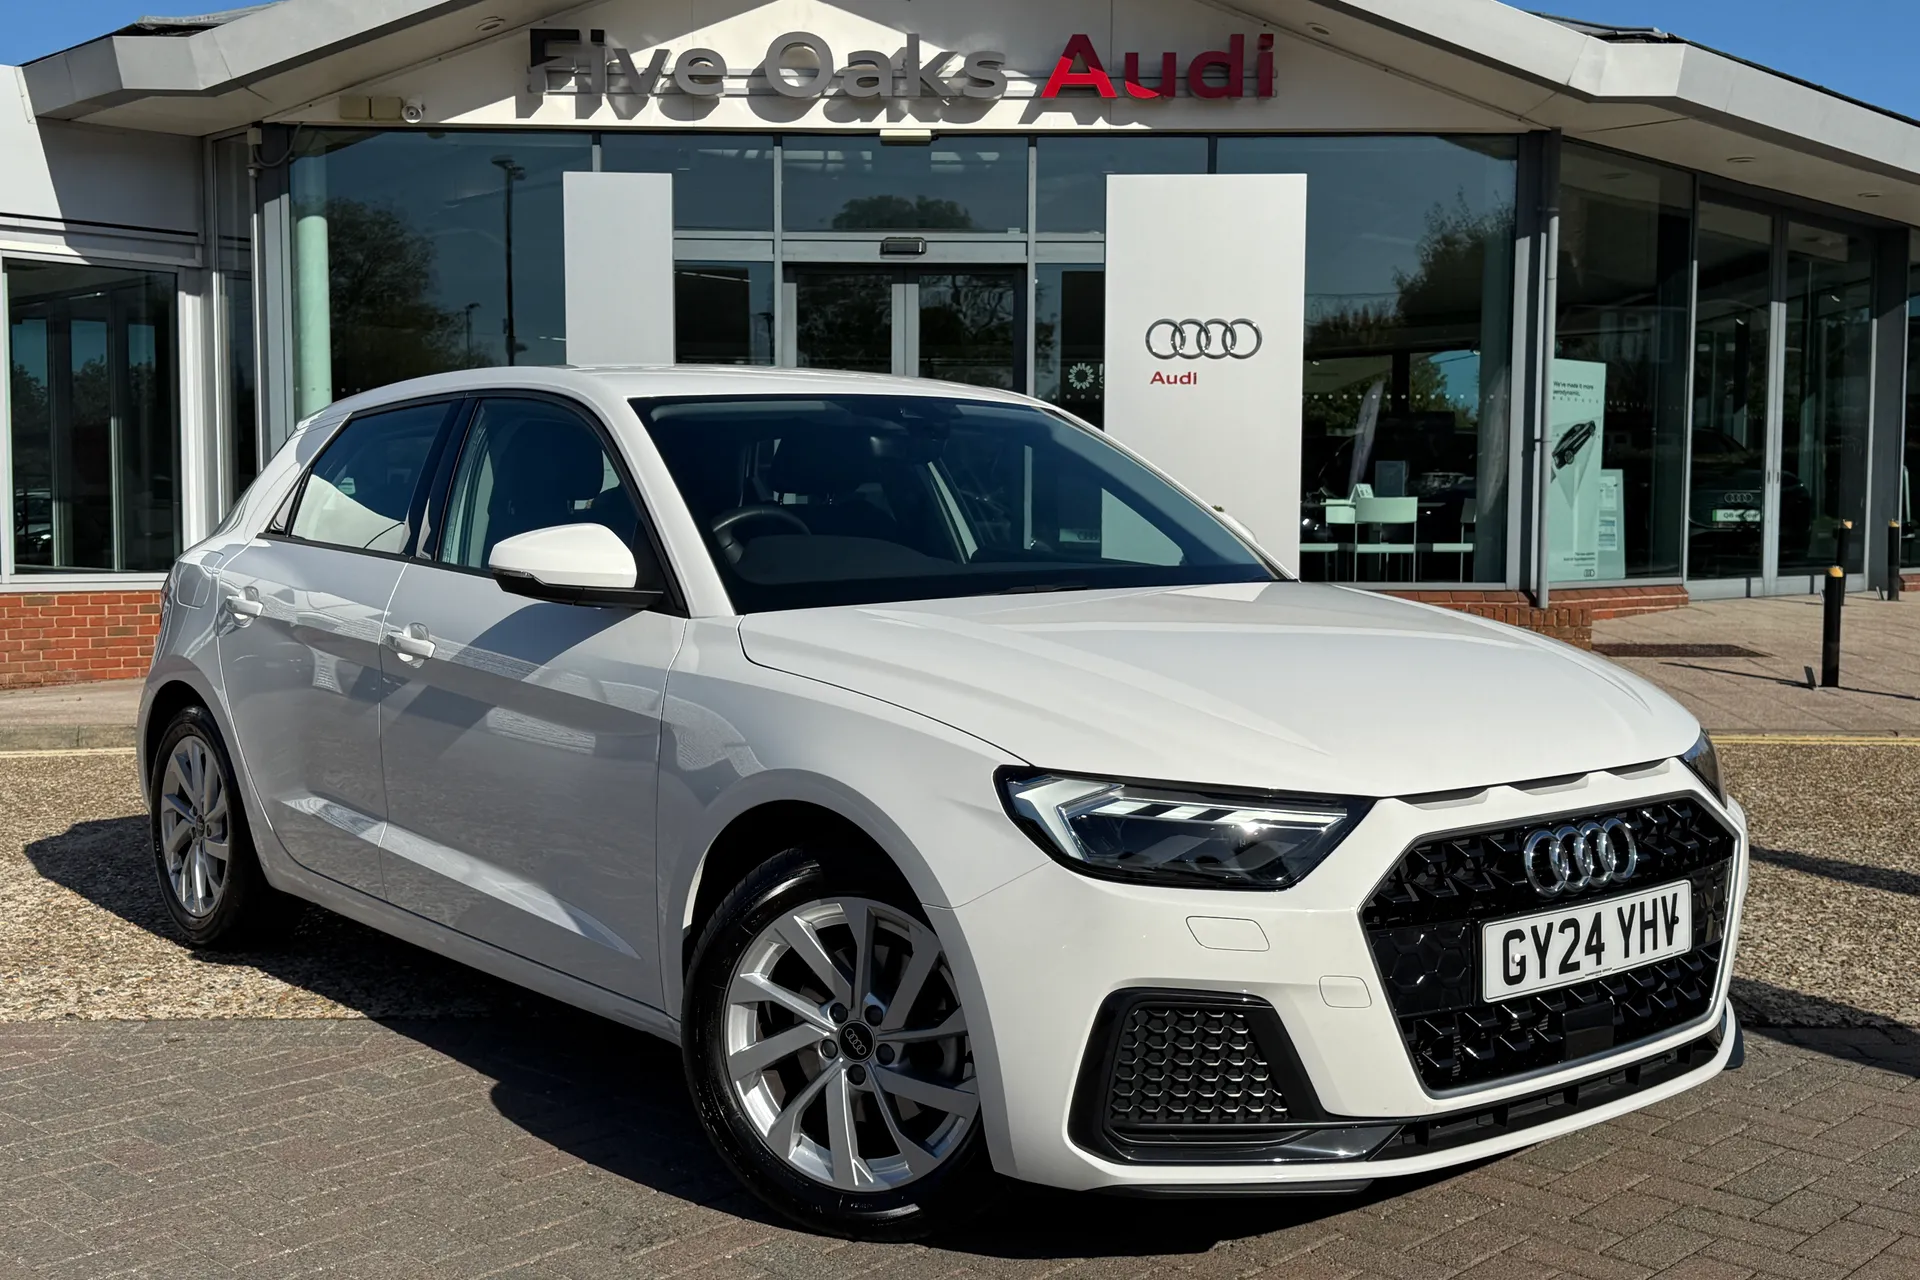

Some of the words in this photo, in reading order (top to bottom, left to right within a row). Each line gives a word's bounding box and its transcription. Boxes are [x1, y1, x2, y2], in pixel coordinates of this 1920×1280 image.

[529, 28, 728, 96] Five
[765, 31, 1008, 98] Oaks
[1040, 34, 1274, 99] Audi
[1150, 371, 1197, 385] Audi
[1502, 912, 1605, 986] GY24
[1617, 893, 1678, 959] YHV
